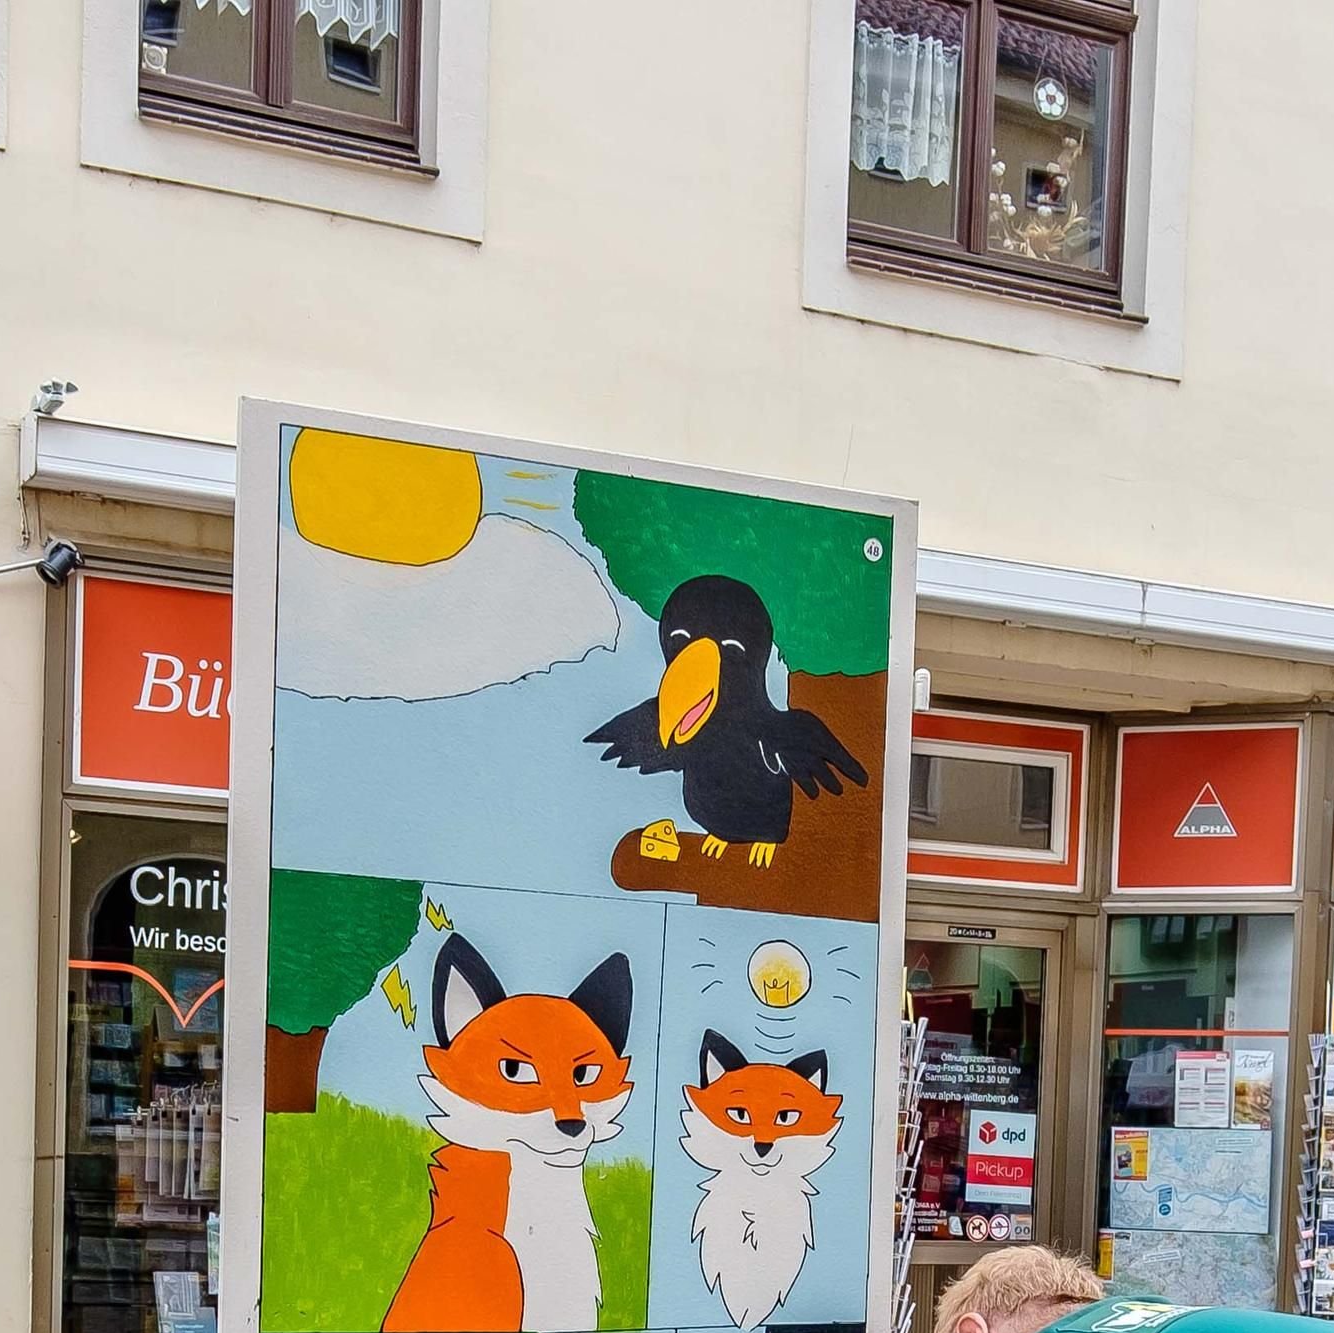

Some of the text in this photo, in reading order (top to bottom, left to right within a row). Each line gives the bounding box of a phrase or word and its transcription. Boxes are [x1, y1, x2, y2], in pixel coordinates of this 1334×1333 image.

[133, 651, 233, 719] Bü
[1180, 824, 1232, 834] ALPHA
[129, 865, 227, 911] Chri
[129, 925, 169, 949] Wir
[925, 1073, 957, 1083] Samstag
[997, 1076, 1011, 1084] Uhr
[1008, 1066, 1021, 1074] Uhr
[1001, 1127, 1027, 1145] dpd
[975, 1161, 1024, 1181] Pickup
